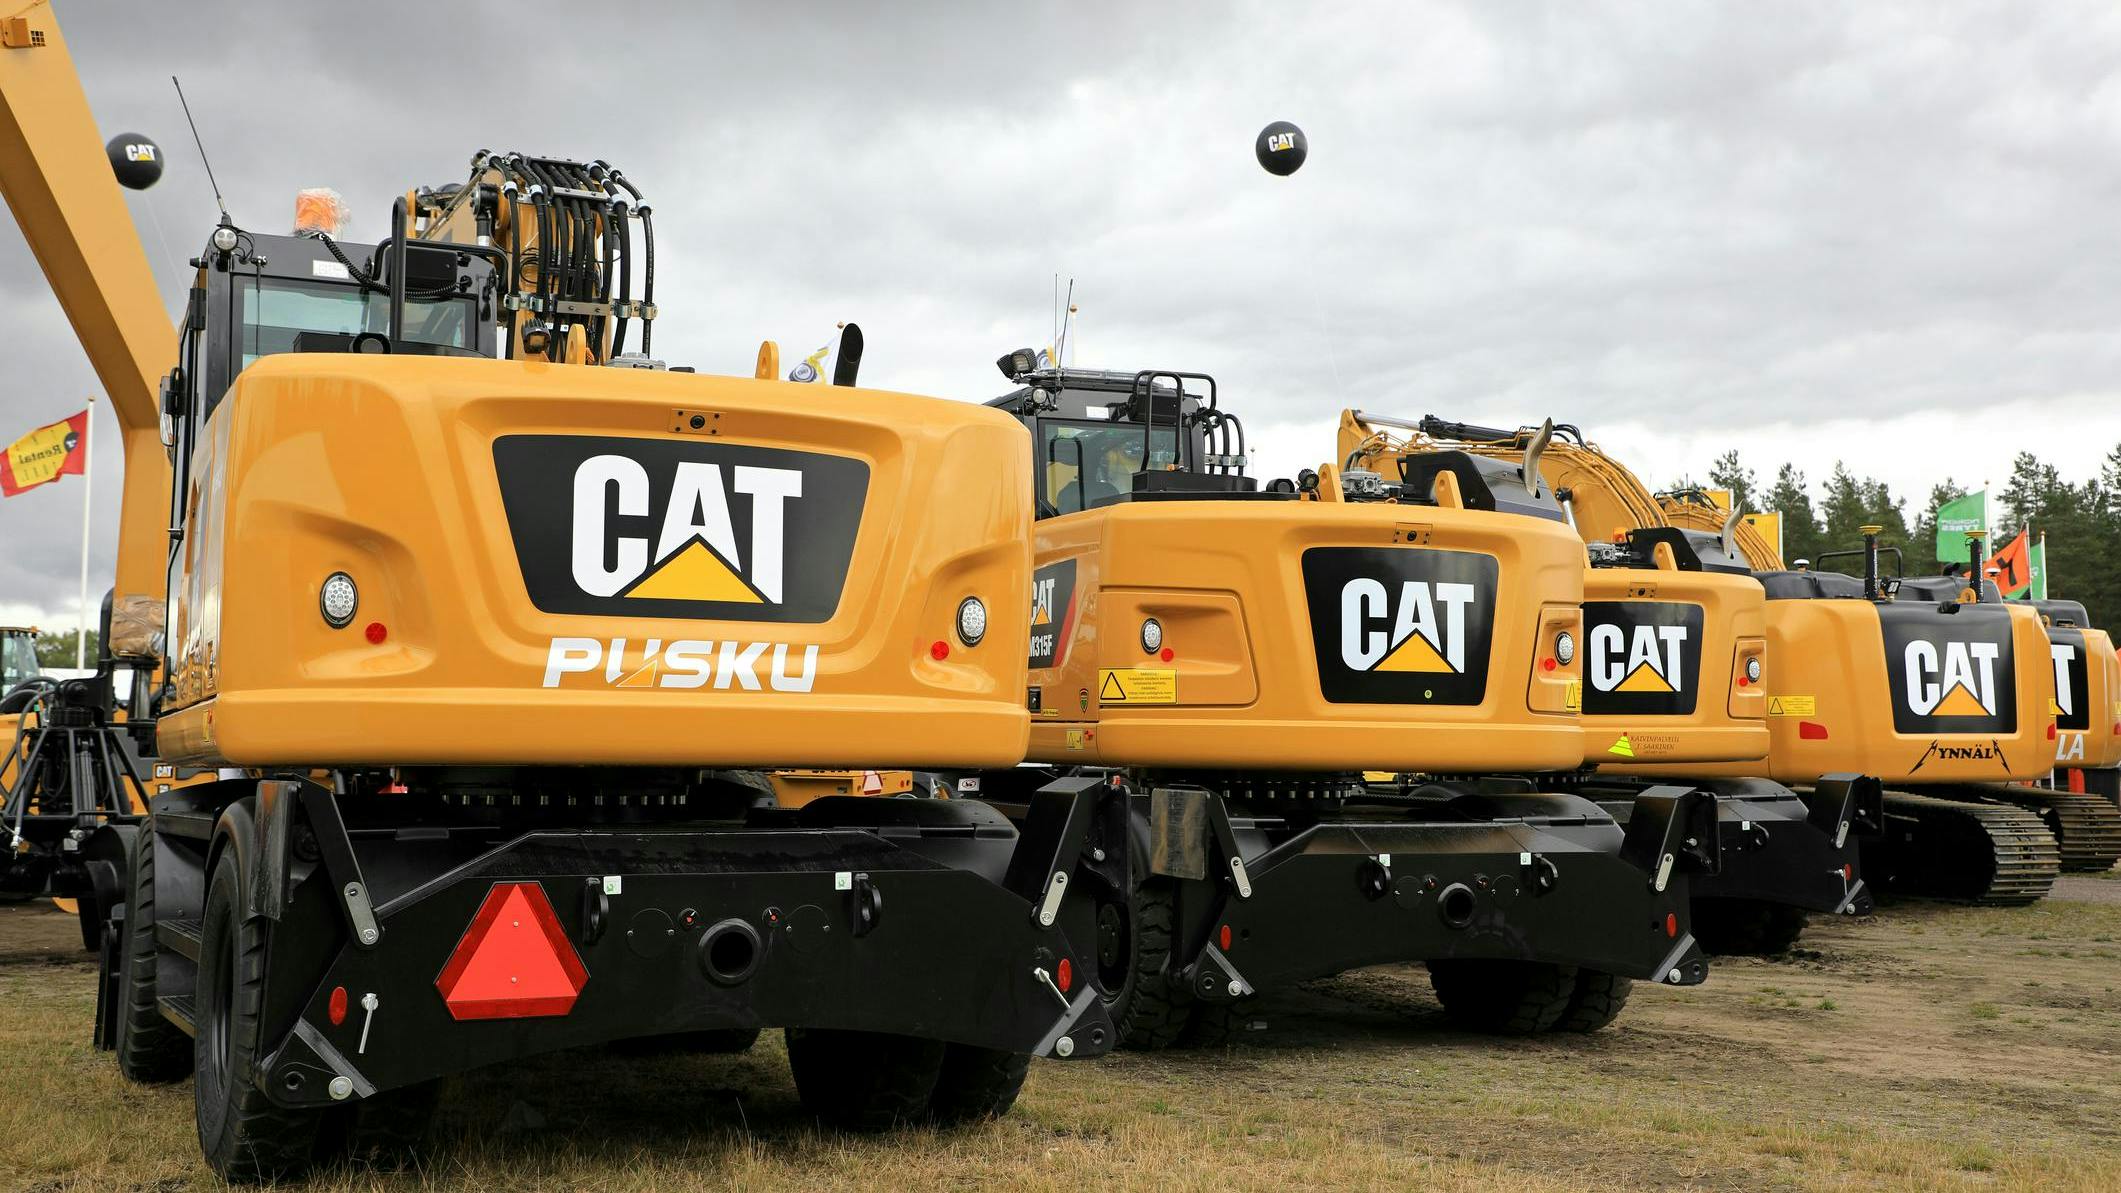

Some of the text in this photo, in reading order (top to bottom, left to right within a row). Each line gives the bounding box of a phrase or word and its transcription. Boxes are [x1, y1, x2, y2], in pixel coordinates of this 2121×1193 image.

[125, 144, 156, 161] CAT
[1268, 133, 1295, 152] CAT
[572, 455, 802, 604] CAT
[1029, 634, 1053, 657] M315F
[1341, 578, 1474, 673] CAT
[542, 637, 819, 693] PUSKU
[1590, 624, 1687, 692] CAT
[1905, 640, 1998, 716] CAT
[156, 765, 172, 778] CAT
